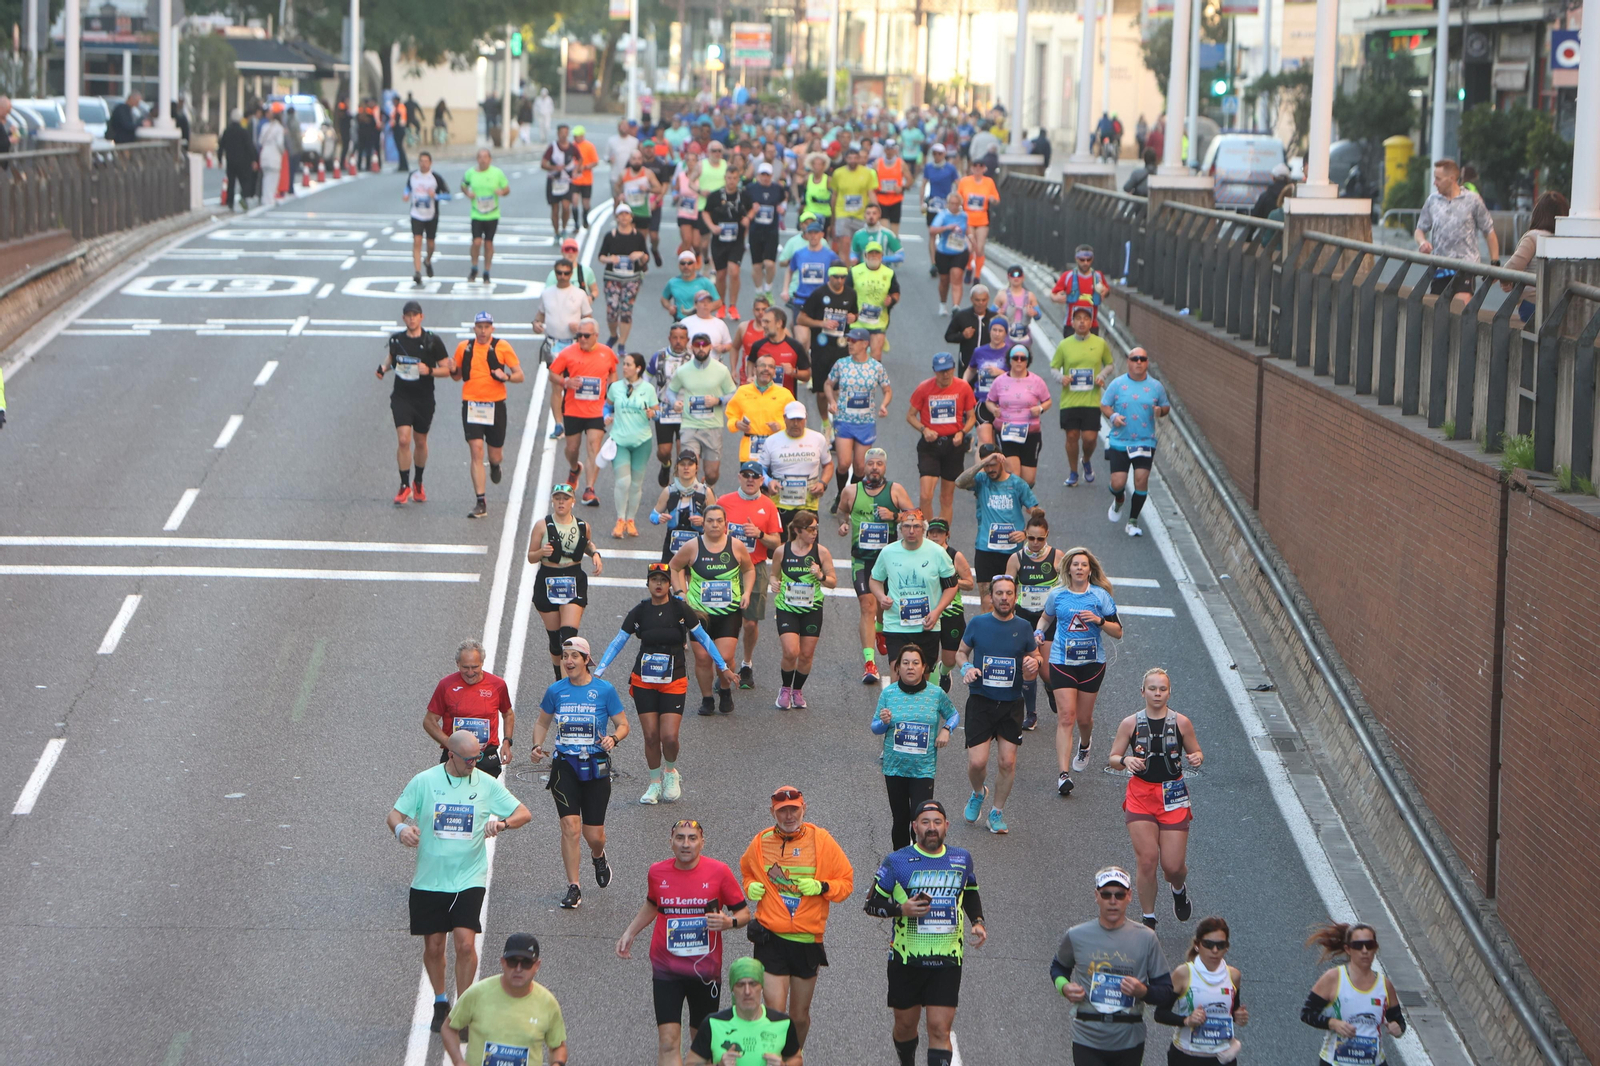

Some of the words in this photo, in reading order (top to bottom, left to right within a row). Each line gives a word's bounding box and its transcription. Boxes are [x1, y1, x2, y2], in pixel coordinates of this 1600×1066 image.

[564, 526, 578, 550] PRO
[907, 870, 964, 888] AMATE
[676, 896, 708, 905] Lentos
[499, 1046, 524, 1056] ZURICH
